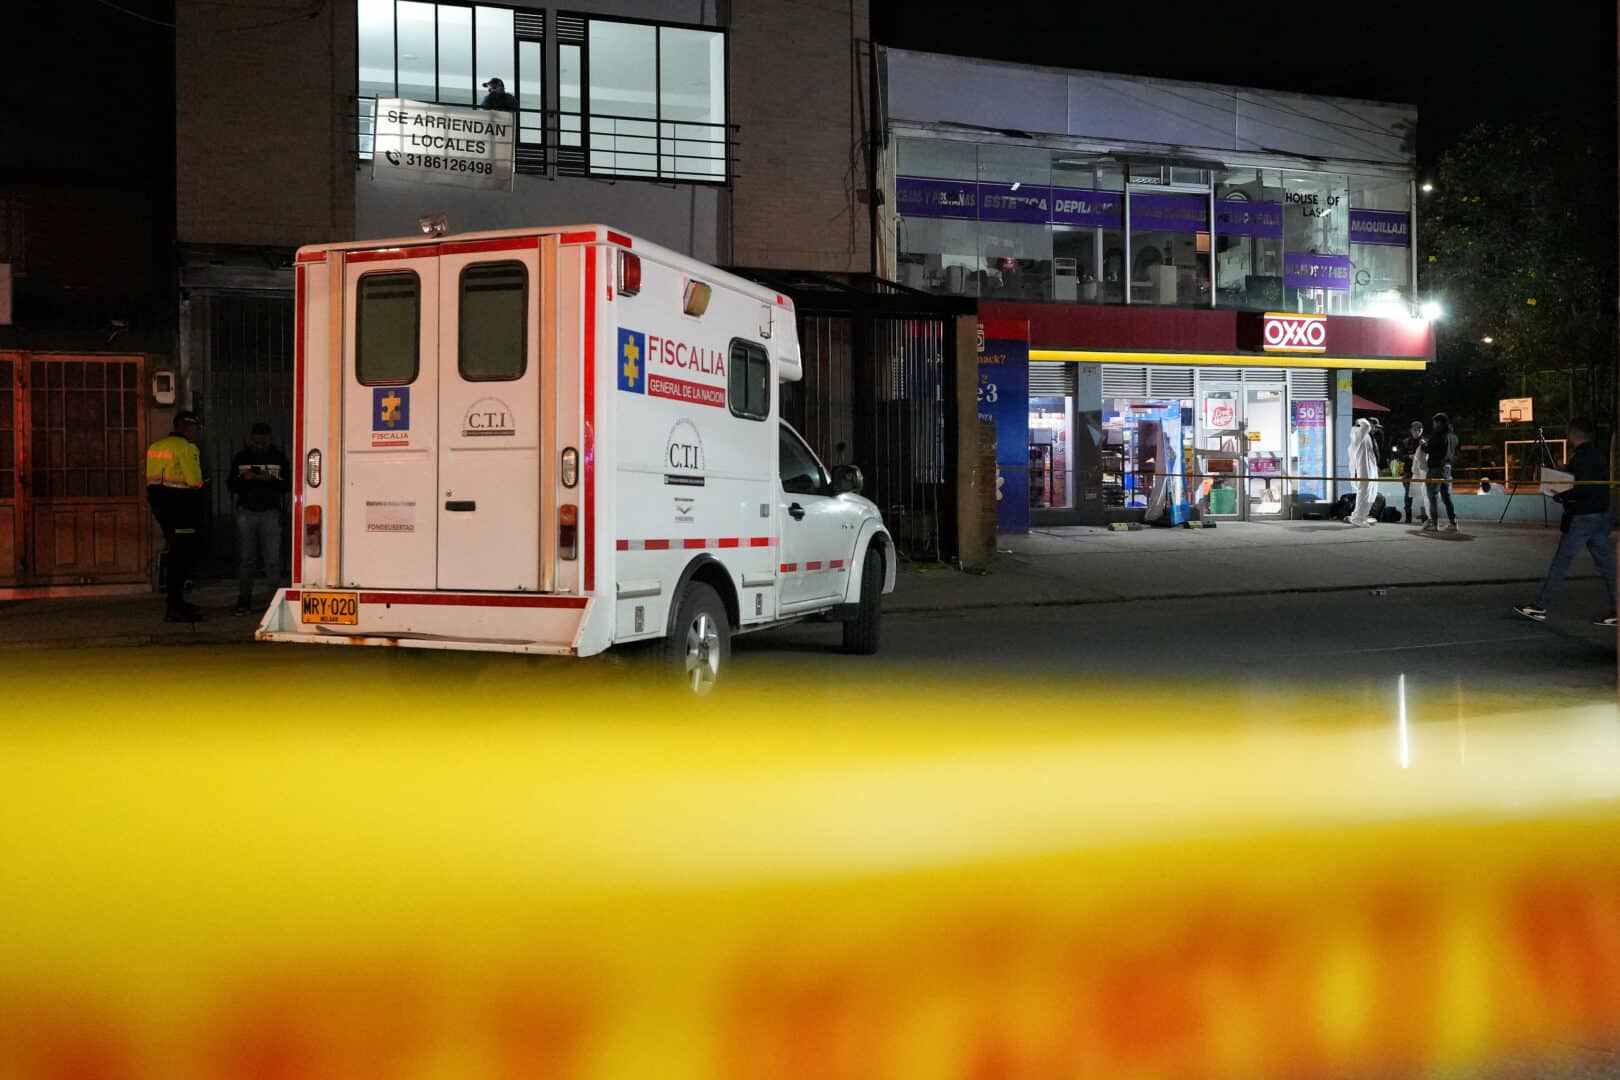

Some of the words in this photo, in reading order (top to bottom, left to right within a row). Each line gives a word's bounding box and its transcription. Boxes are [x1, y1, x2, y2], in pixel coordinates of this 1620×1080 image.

[387, 110, 408, 125] SE
[413, 113, 506, 137] ARRIENDAN
[411, 133, 486, 154] LOCALES
[406, 153, 493, 175] 3186126498
[1285, 192, 1319, 205] HOUSE
[1327, 195, 1341, 206] OF
[1351, 219, 1408, 235] MAQUILLAJE
[1264, 319, 1326, 346] OXXO
[648, 335, 726, 377] FISCALIA
[976, 354, 1006, 365] nack?
[650, 378, 682, 397] GENERAL
[682, 385, 692, 398] DE
[692, 387, 701, 400] LA
[371, 432, 409, 440] FISCALIA
